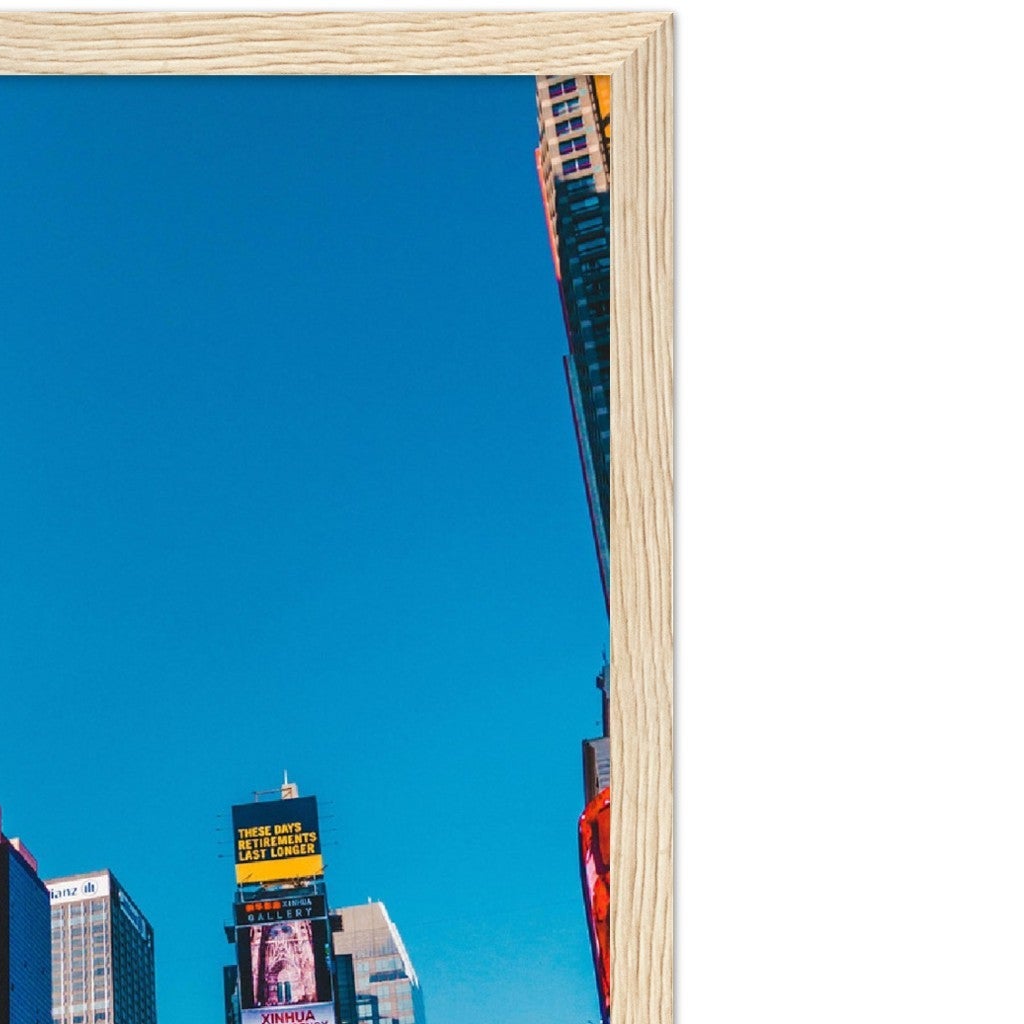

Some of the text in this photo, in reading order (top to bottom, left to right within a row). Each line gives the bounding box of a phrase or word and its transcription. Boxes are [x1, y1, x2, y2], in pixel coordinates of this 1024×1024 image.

[238, 822, 302, 839] THESE DAYS
[238, 832, 317, 850] RETIREMENTS
[239, 843, 315, 861] LAST LONGER
[50, 887, 78, 899] ianz
[247, 908, 312, 922] GALLERY
[261, 1010, 315, 1024] XINHUA
